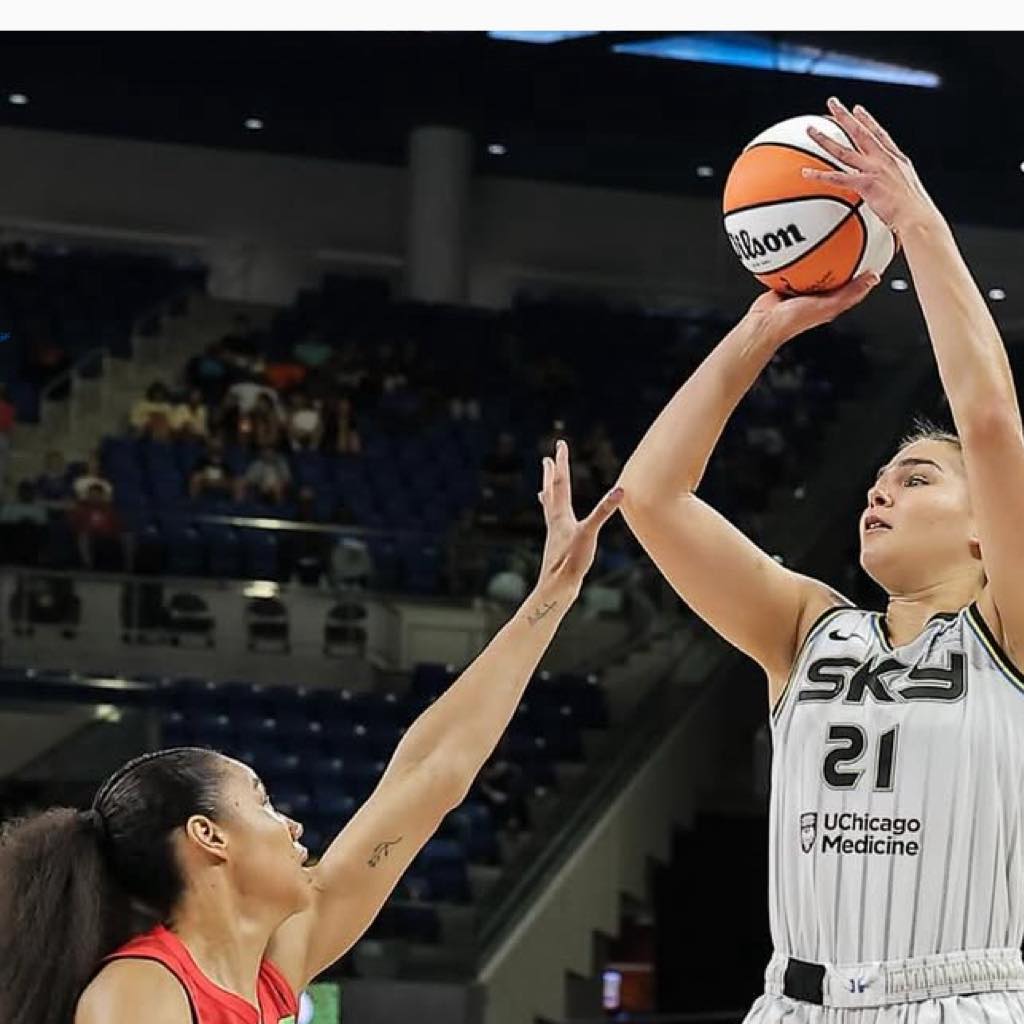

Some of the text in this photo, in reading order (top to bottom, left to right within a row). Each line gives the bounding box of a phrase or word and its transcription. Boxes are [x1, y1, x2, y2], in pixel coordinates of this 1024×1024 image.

[728, 223, 807, 260] ilson
[822, 722, 900, 792] 21
[823, 812, 921, 833] UChicago
[821, 834, 919, 856] Medicine
